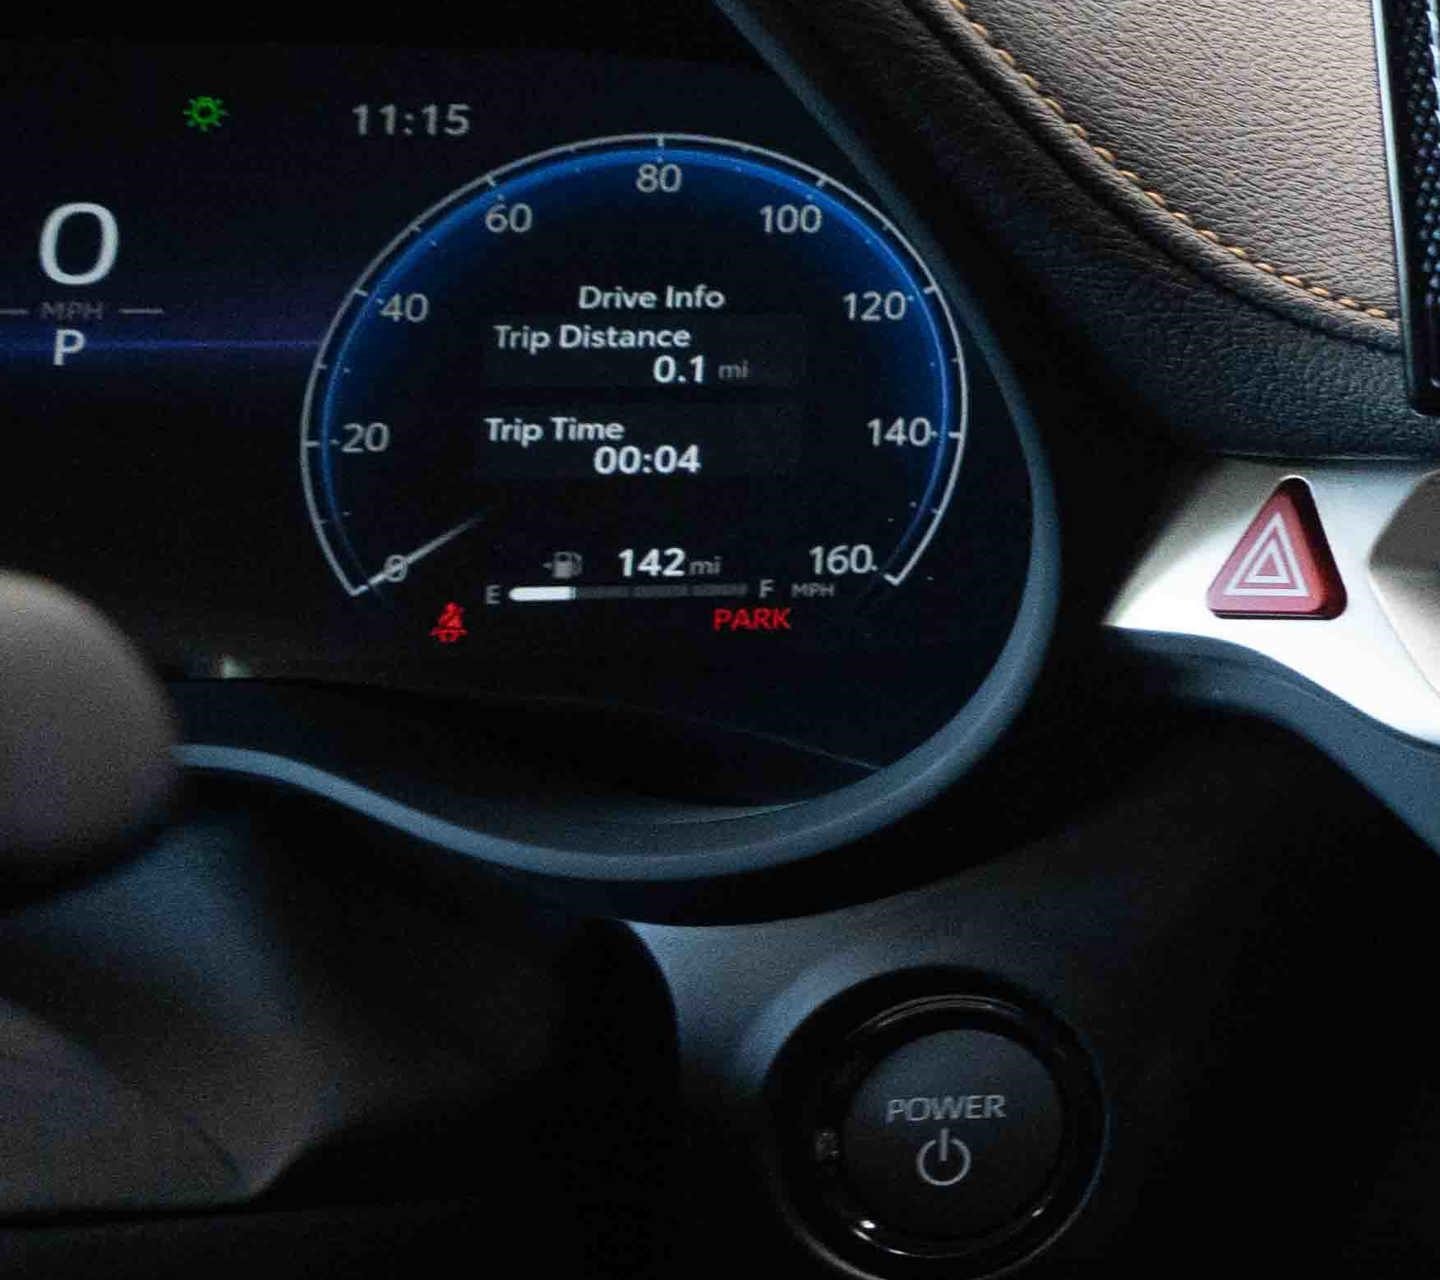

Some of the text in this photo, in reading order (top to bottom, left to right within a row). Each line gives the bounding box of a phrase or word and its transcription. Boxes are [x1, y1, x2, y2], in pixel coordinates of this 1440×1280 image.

[352, 103, 470, 136] 11:15
[636, 162, 683, 195] 80
[485, 201, 534, 234] 60
[760, 203, 824, 235] 100
[40, 300, 104, 321] MPH
[383, 291, 429, 323] 40
[578, 284, 725, 309] Drive Info
[844, 290, 907, 322] 120
[53, 331, 87, 366] P
[494, 324, 691, 355] Trip Distance
[653, 354, 749, 384] 0.1 mi
[341, 422, 389, 453] 20
[484, 416, 625, 448] Trip Time
[867, 416, 931, 448] 140
[593, 444, 701, 475] 00:04
[383, 555, 408, 584] 0
[618, 547, 721, 577] 142 mi
[809, 543, 872, 575] 160
[485, 584, 501, 605] E
[759, 578, 774, 598] F
[791, 582, 835, 597] MPH
[713, 607, 790, 630] PARK
[886, 1094, 1006, 1123] POWER
